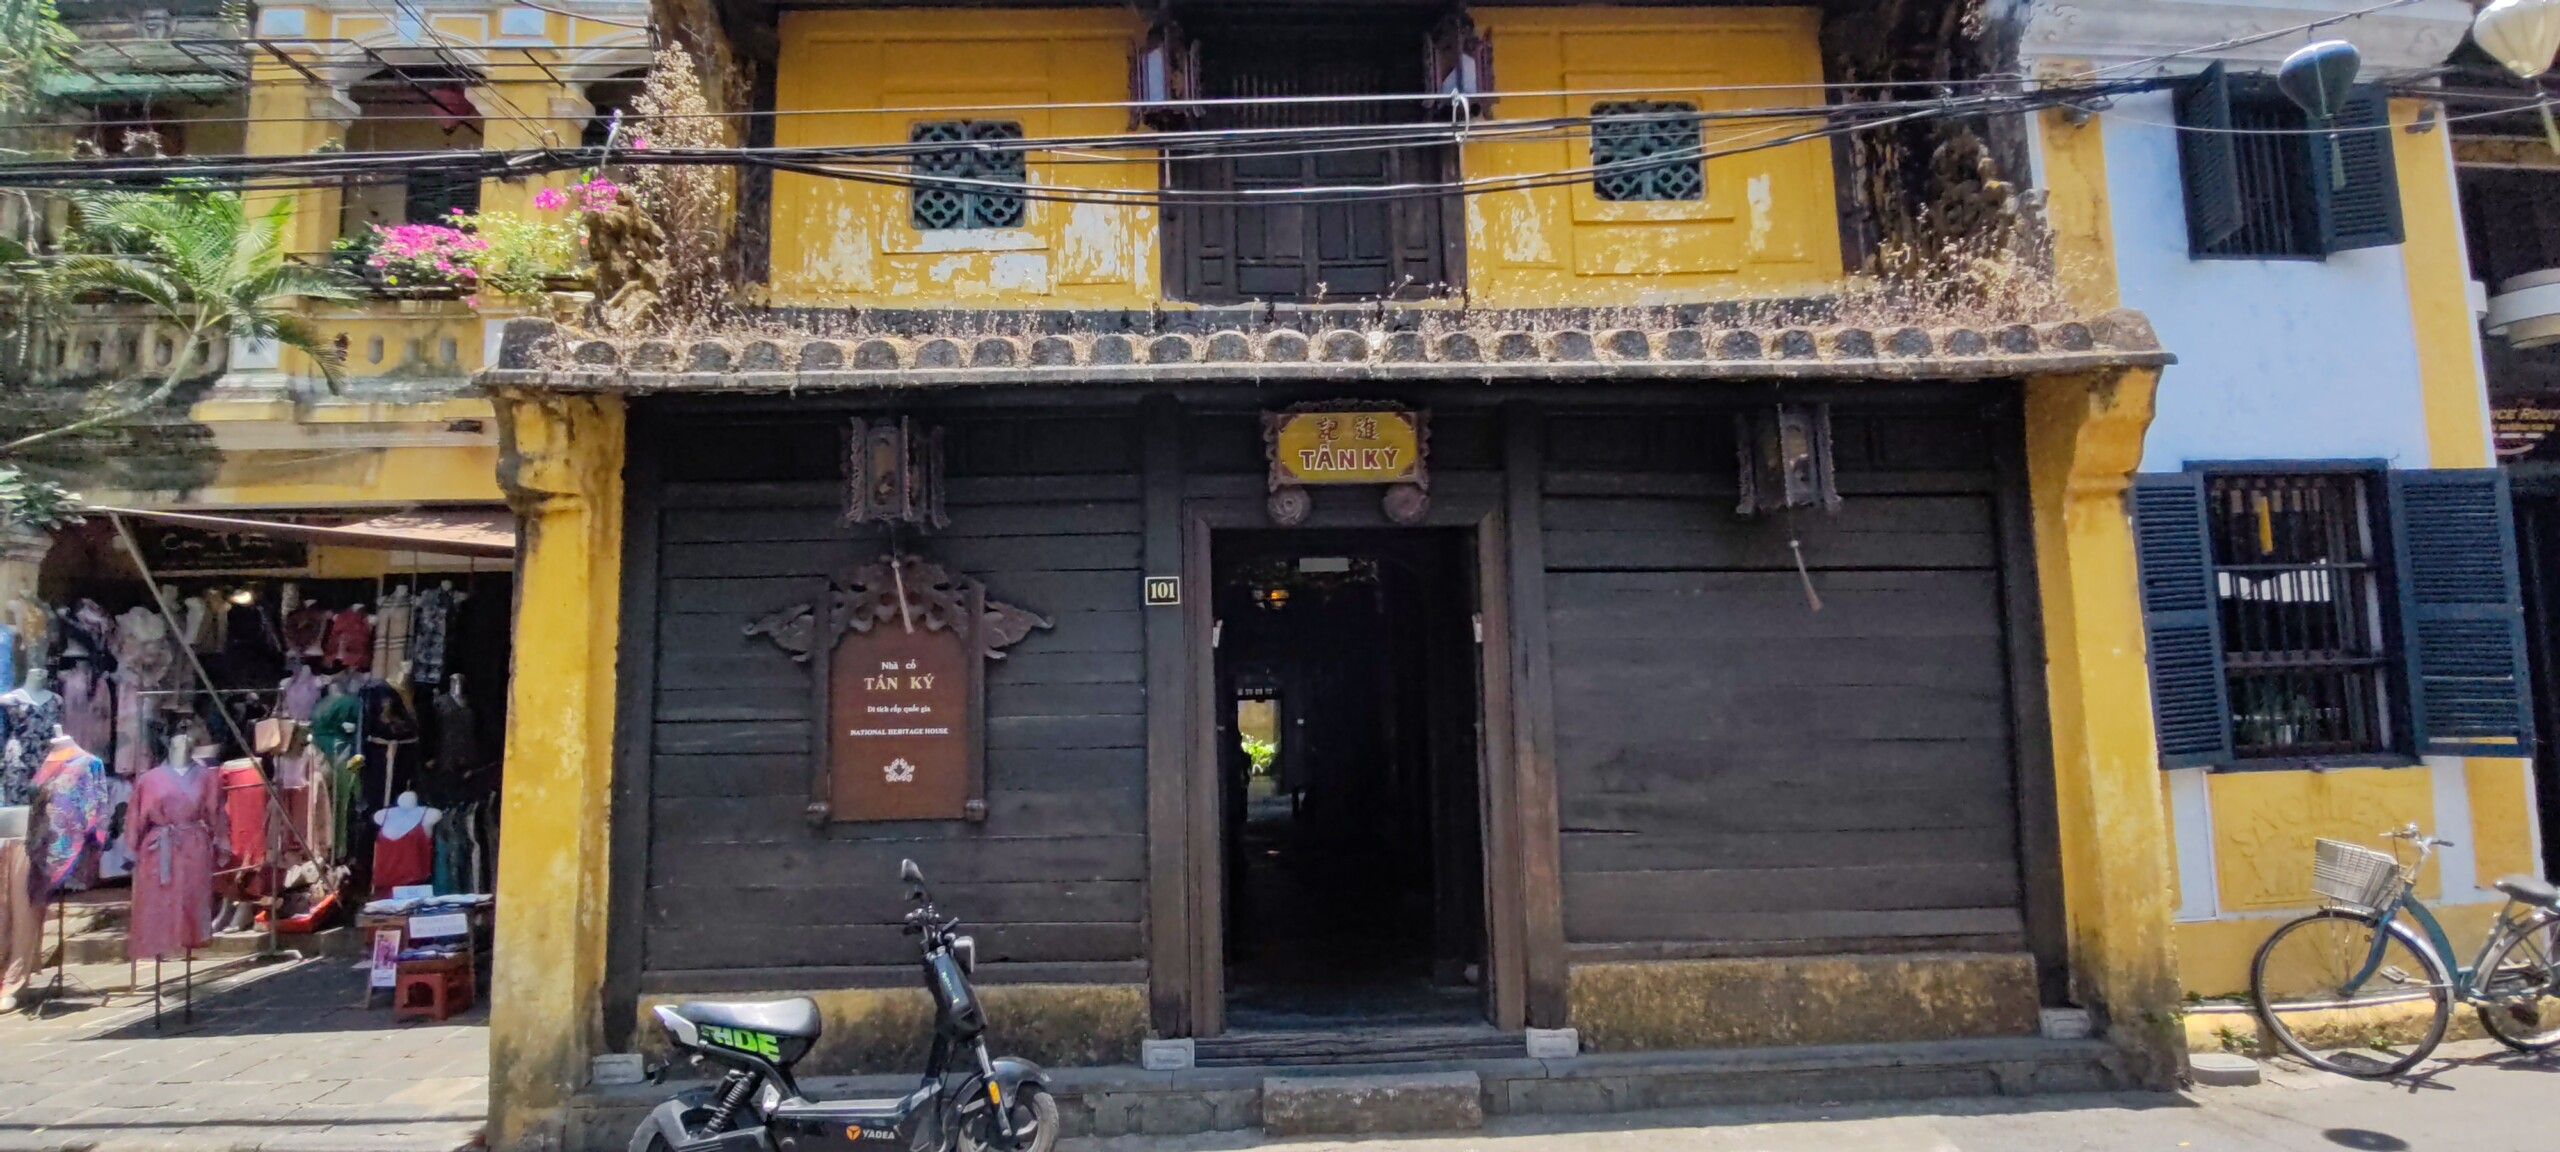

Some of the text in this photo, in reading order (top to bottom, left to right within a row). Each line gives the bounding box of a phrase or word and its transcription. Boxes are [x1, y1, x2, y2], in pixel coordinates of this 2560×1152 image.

[1151, 582, 1175, 599] 101
[909, 672, 935, 690] KÝ
[850, 727, 949, 737] NATIONAL HERITAGE HOUSE
[862, 1129, 895, 1140] YADEA
